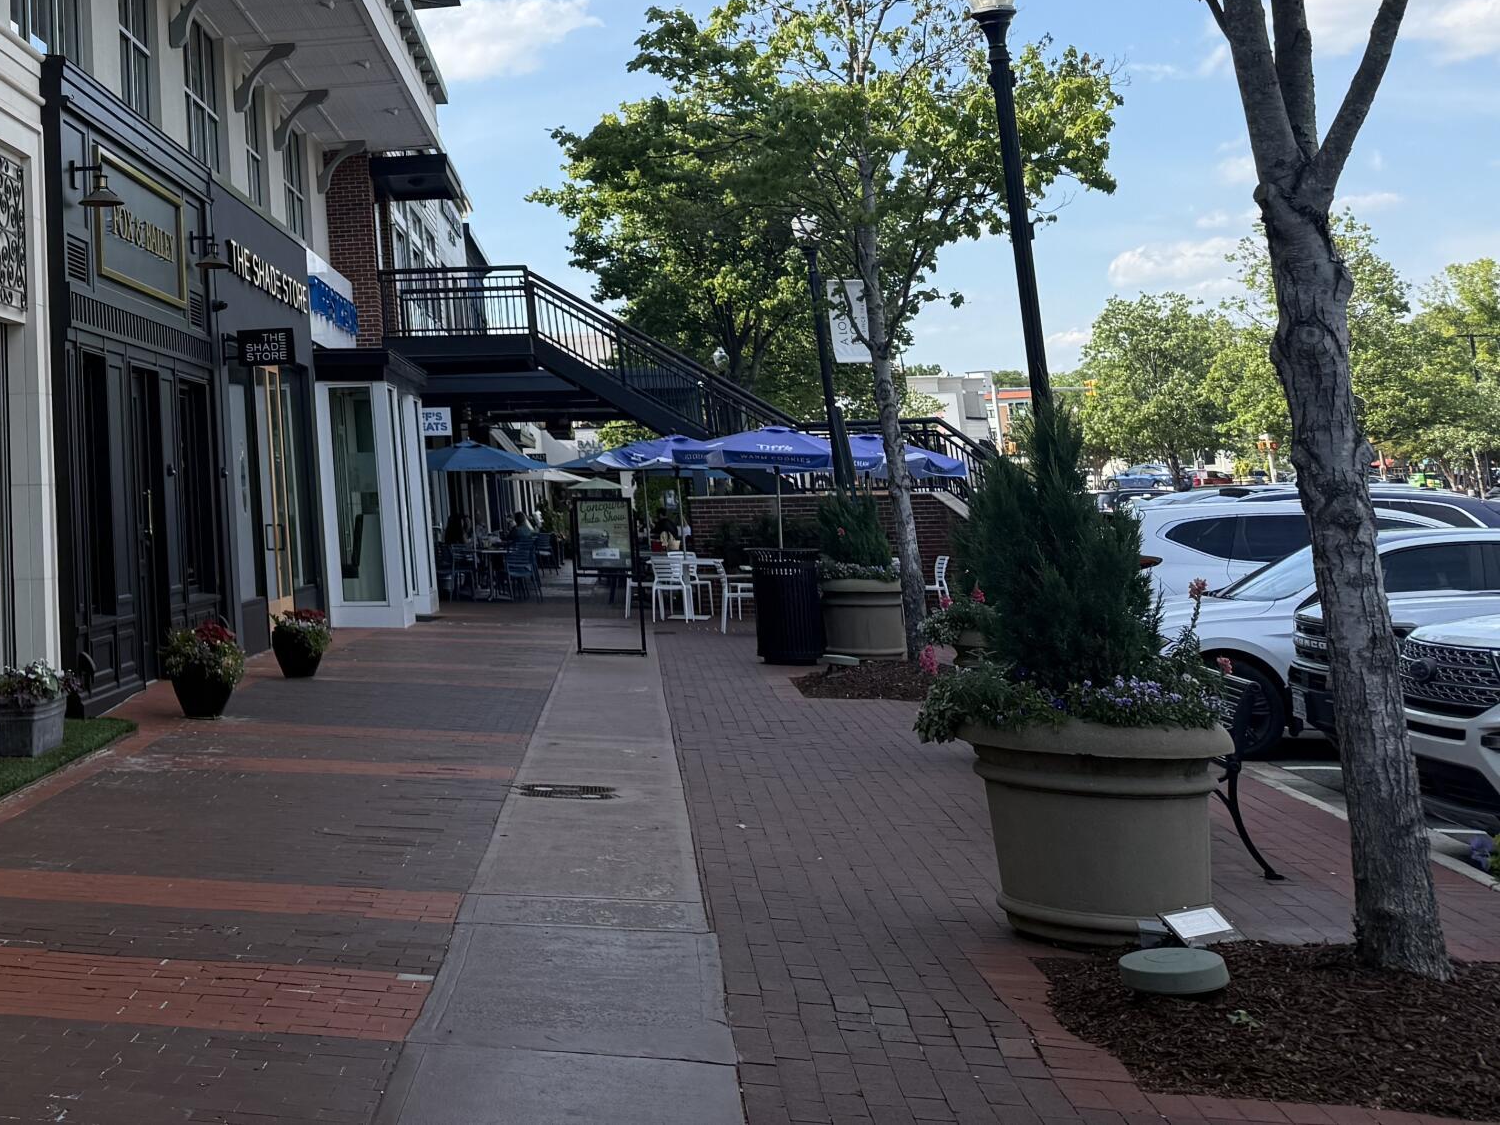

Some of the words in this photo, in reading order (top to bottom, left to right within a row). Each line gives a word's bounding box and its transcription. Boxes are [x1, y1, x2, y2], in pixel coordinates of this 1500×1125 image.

[112, 204, 135, 243] FOX
[135, 216, 146, 248] &
[146, 221, 175, 263] BAILEY
[229, 239, 251, 283] THE
[251, 254, 282, 299] SHADE
[281, 273, 308, 315] STORE
[262, 332, 286, 342] THE
[245, 341, 287, 353] SHADE
[246, 351, 287, 361] STORE
[771, 455, 811, 464] COOKIES
[581, 512, 600, 523] Auto
[602, 510, 626, 523] Show
